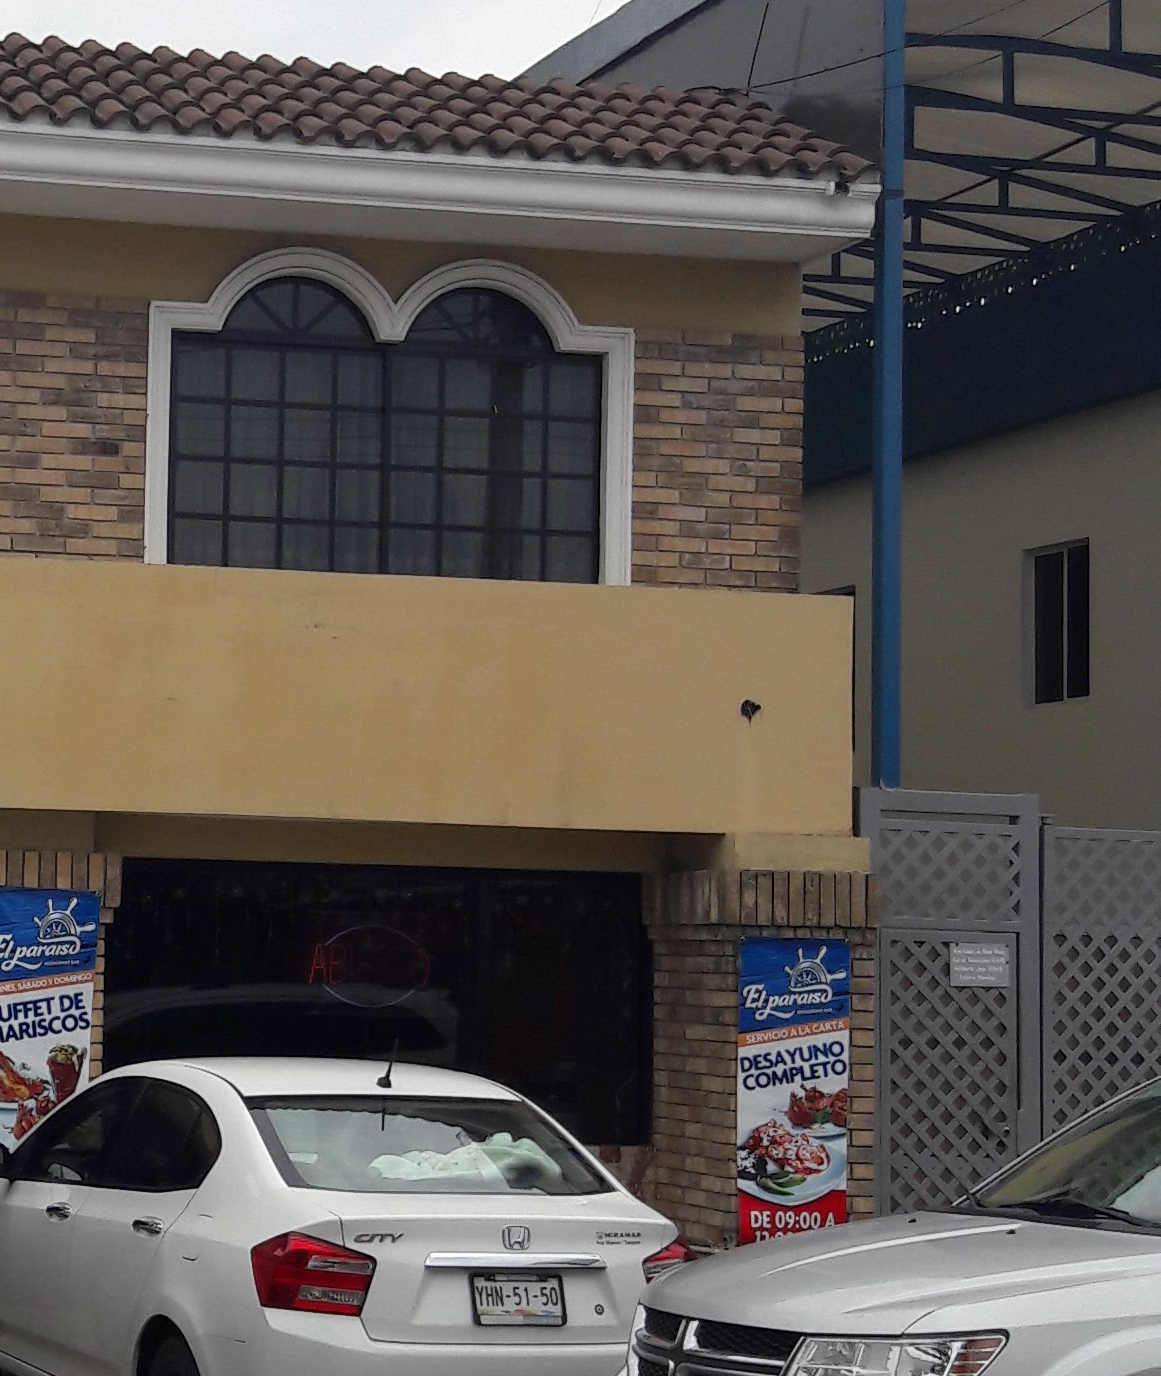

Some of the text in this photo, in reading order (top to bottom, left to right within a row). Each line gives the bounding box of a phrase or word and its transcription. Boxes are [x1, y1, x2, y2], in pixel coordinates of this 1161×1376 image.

[47, 977, 54, 987] Y
[54, 971, 93, 985] DOMINGO
[58, 991, 86, 1013] DE
[743, 984, 766, 1009] El
[745, 1020, 846, 1045] SERVICIO A LA CARTA
[739, 1040, 845, 1073] DESAYUNO
[742, 1059, 847, 1091] COMPLETO
[750, 1210, 836, 1231] DE 09:00 A
[353, 1232, 404, 1244] CITY
[475, 1285, 559, 1307] YHN-51-50
